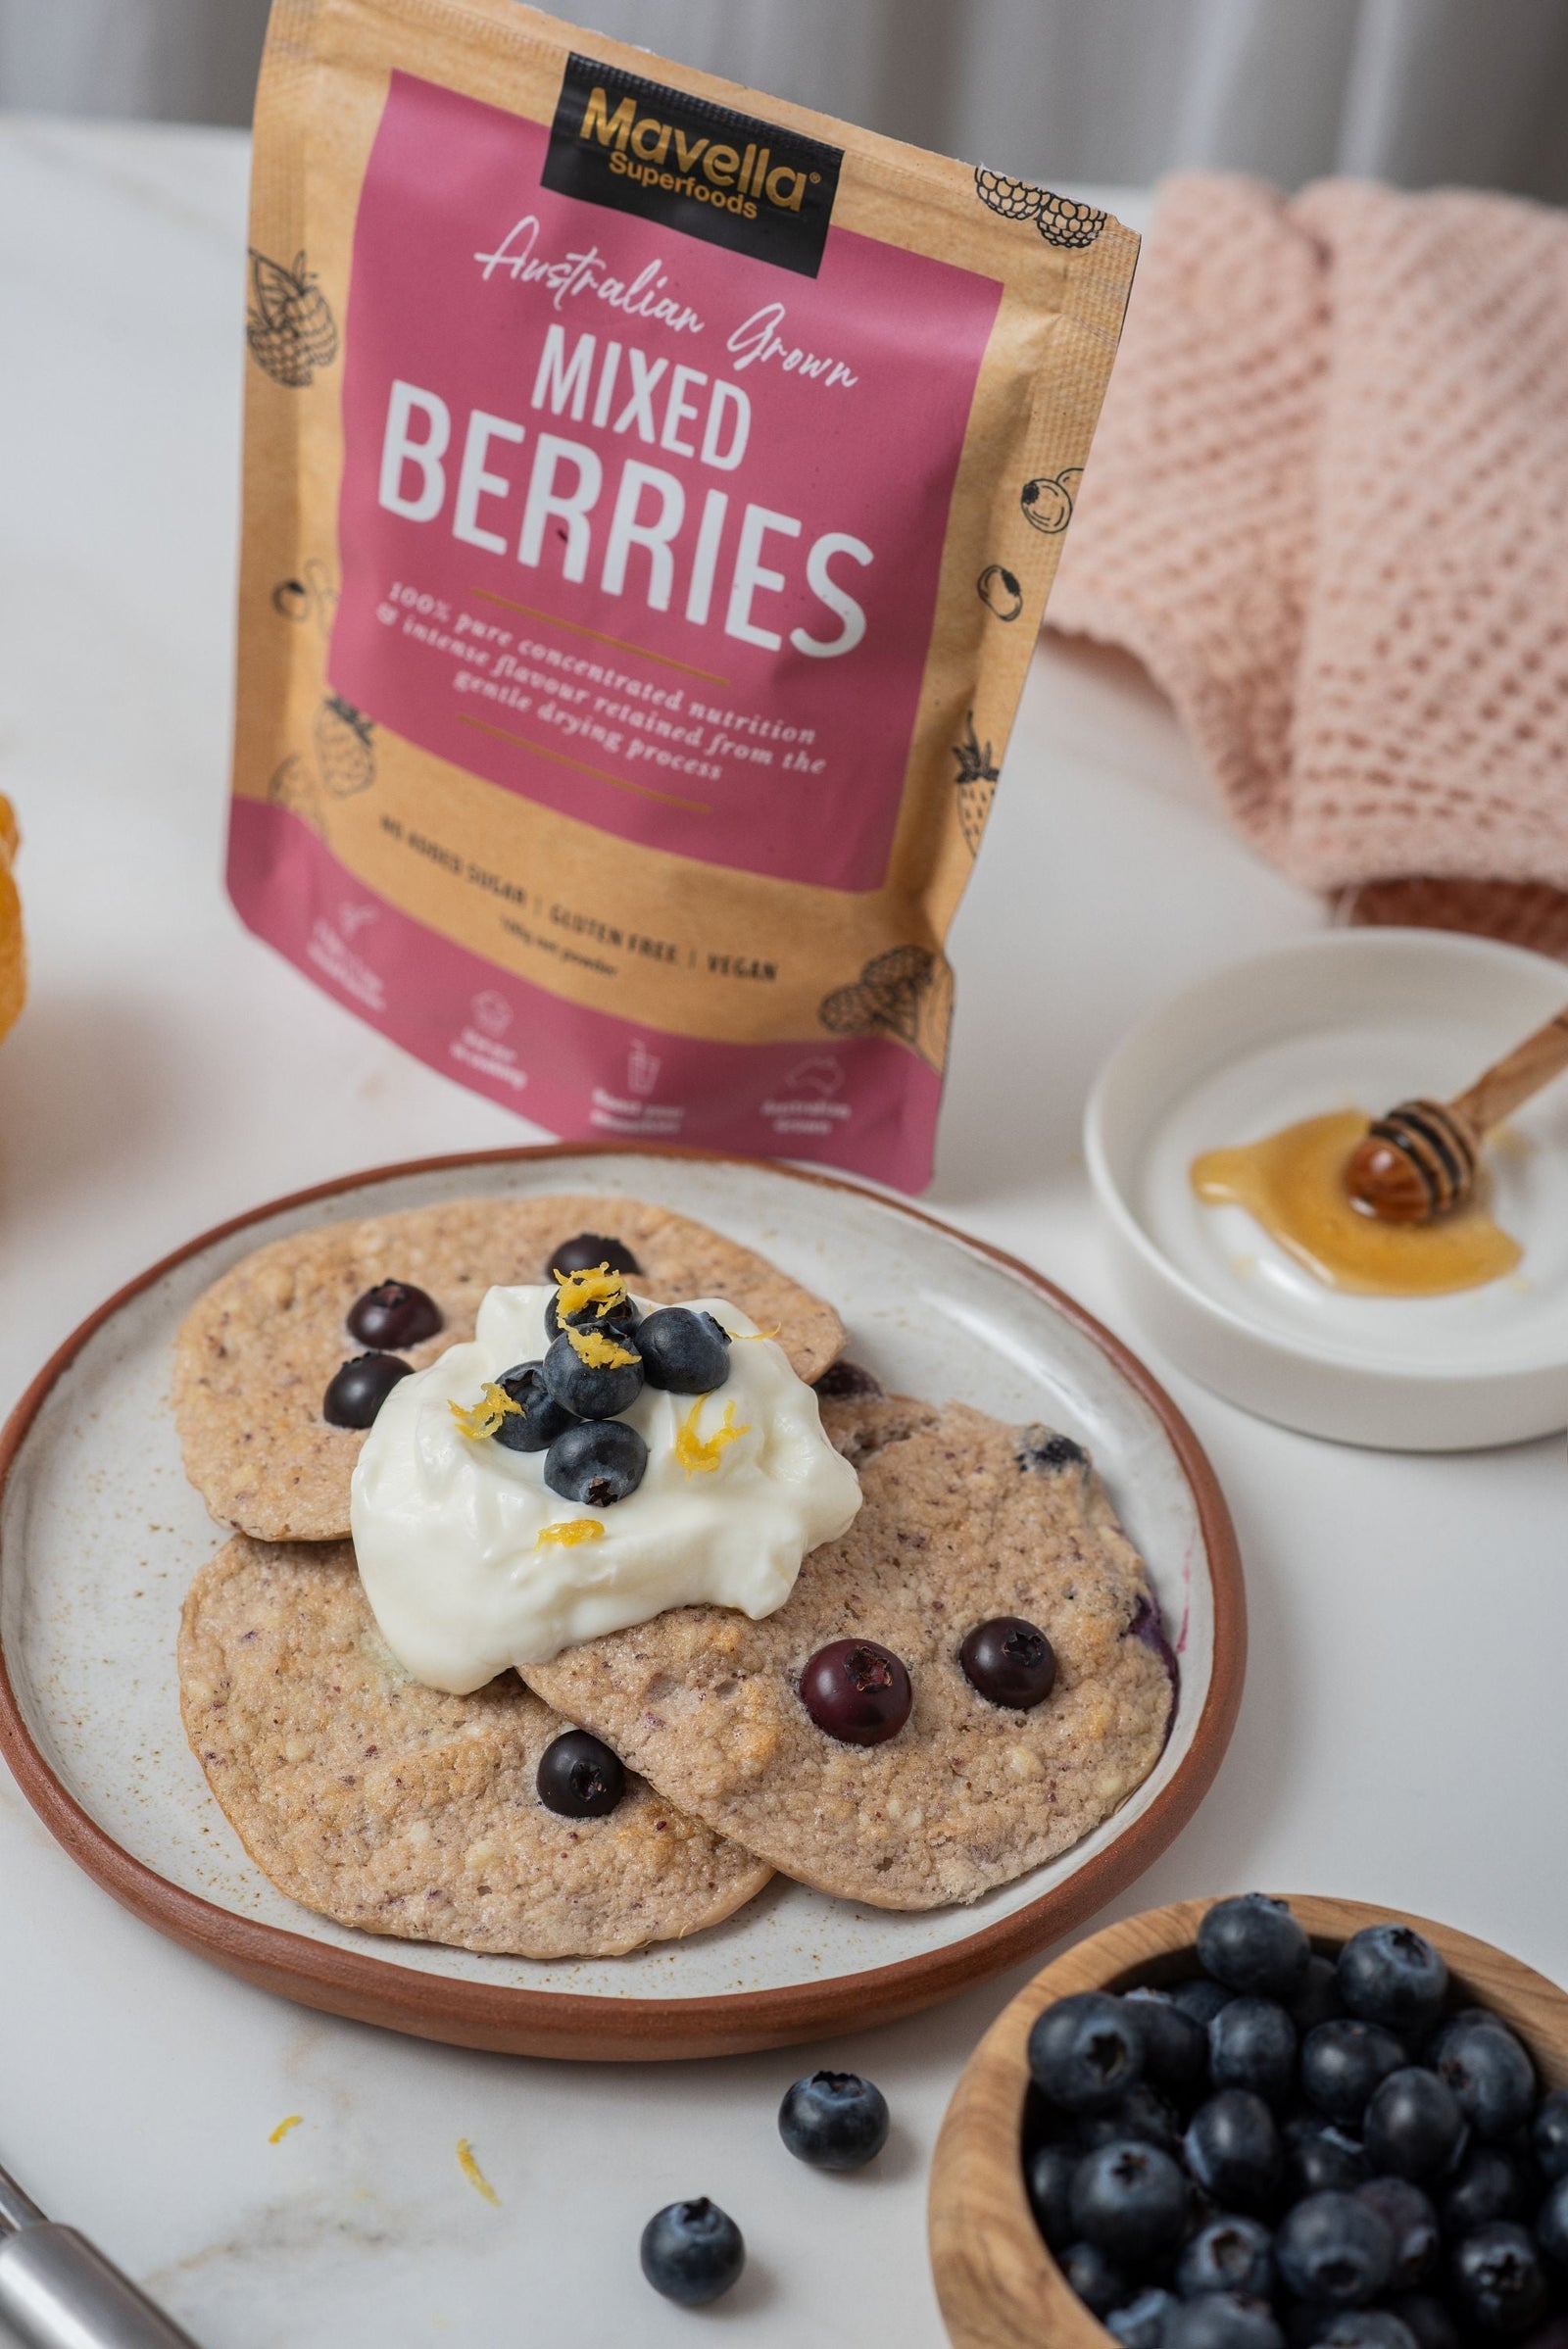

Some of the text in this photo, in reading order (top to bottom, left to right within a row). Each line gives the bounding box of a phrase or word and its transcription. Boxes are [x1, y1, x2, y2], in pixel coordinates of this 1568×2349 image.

[609, 150, 759, 220] Superfoods
[473, 215, 858, 389] Australian Grown
[530, 323, 752, 471] MIXED
[377, 378, 874, 659] BERRIES
[389, 581, 816, 745] 100% pure concentrated nutrition
[402, 614, 490, 667] intense
[490, 654, 590, 704] flavour
[593, 696, 705, 748] retained
[705, 733, 774, 766] from
[782, 750, 826, 774] the
[453, 669, 722, 780] gentle drying process
[407, 832, 463, 875] ADDED
[466, 862, 527, 906] SUGAR
[550, 903, 622, 946] GLUTEN
[627, 933, 677, 963] FREE
[706, 953, 777, 980] VEGAN
